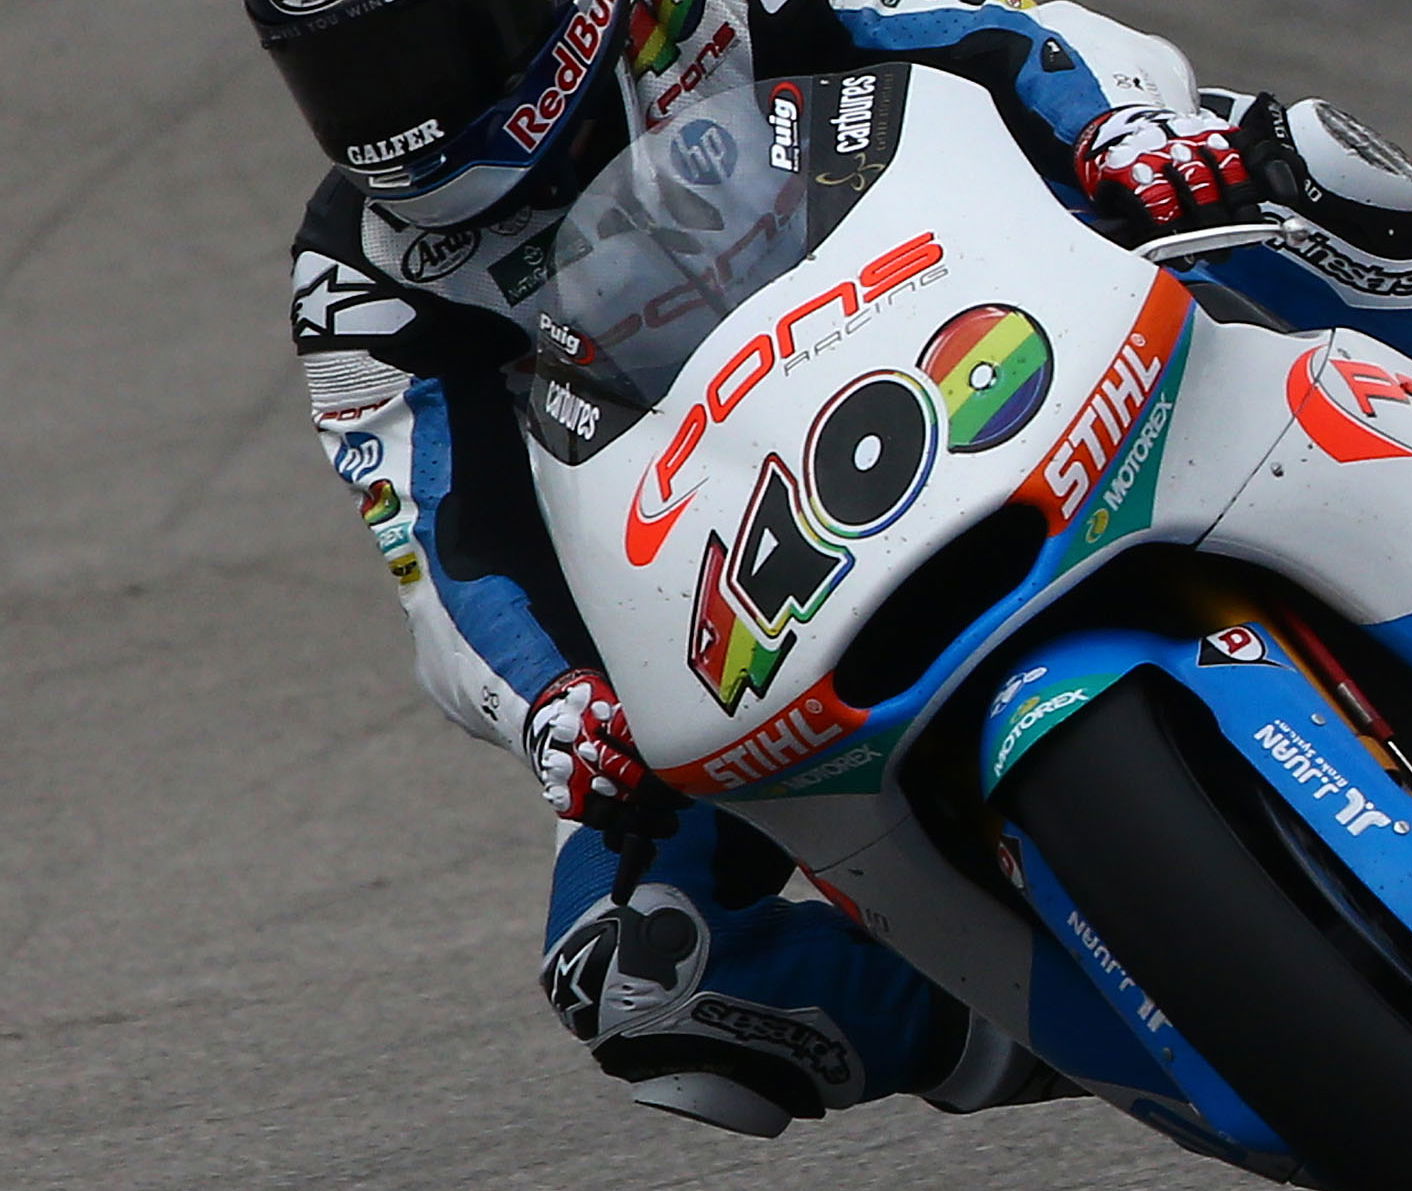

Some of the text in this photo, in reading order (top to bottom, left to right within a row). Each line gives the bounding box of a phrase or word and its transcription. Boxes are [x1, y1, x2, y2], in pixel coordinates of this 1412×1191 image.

[346, 119, 446, 166] GALFER
[770, 97, 798, 171] Puig
[830, 75, 877, 154] carbures
[539, 312, 581, 356] Puig
[1043, 344, 1162, 521] STIHL
[1103, 392, 1173, 512] MOTOREX
[703, 707, 843, 790] STIHL
[993, 688, 1090, 778] MOTOREX
[1253, 723, 1341, 801] J.JUAN
